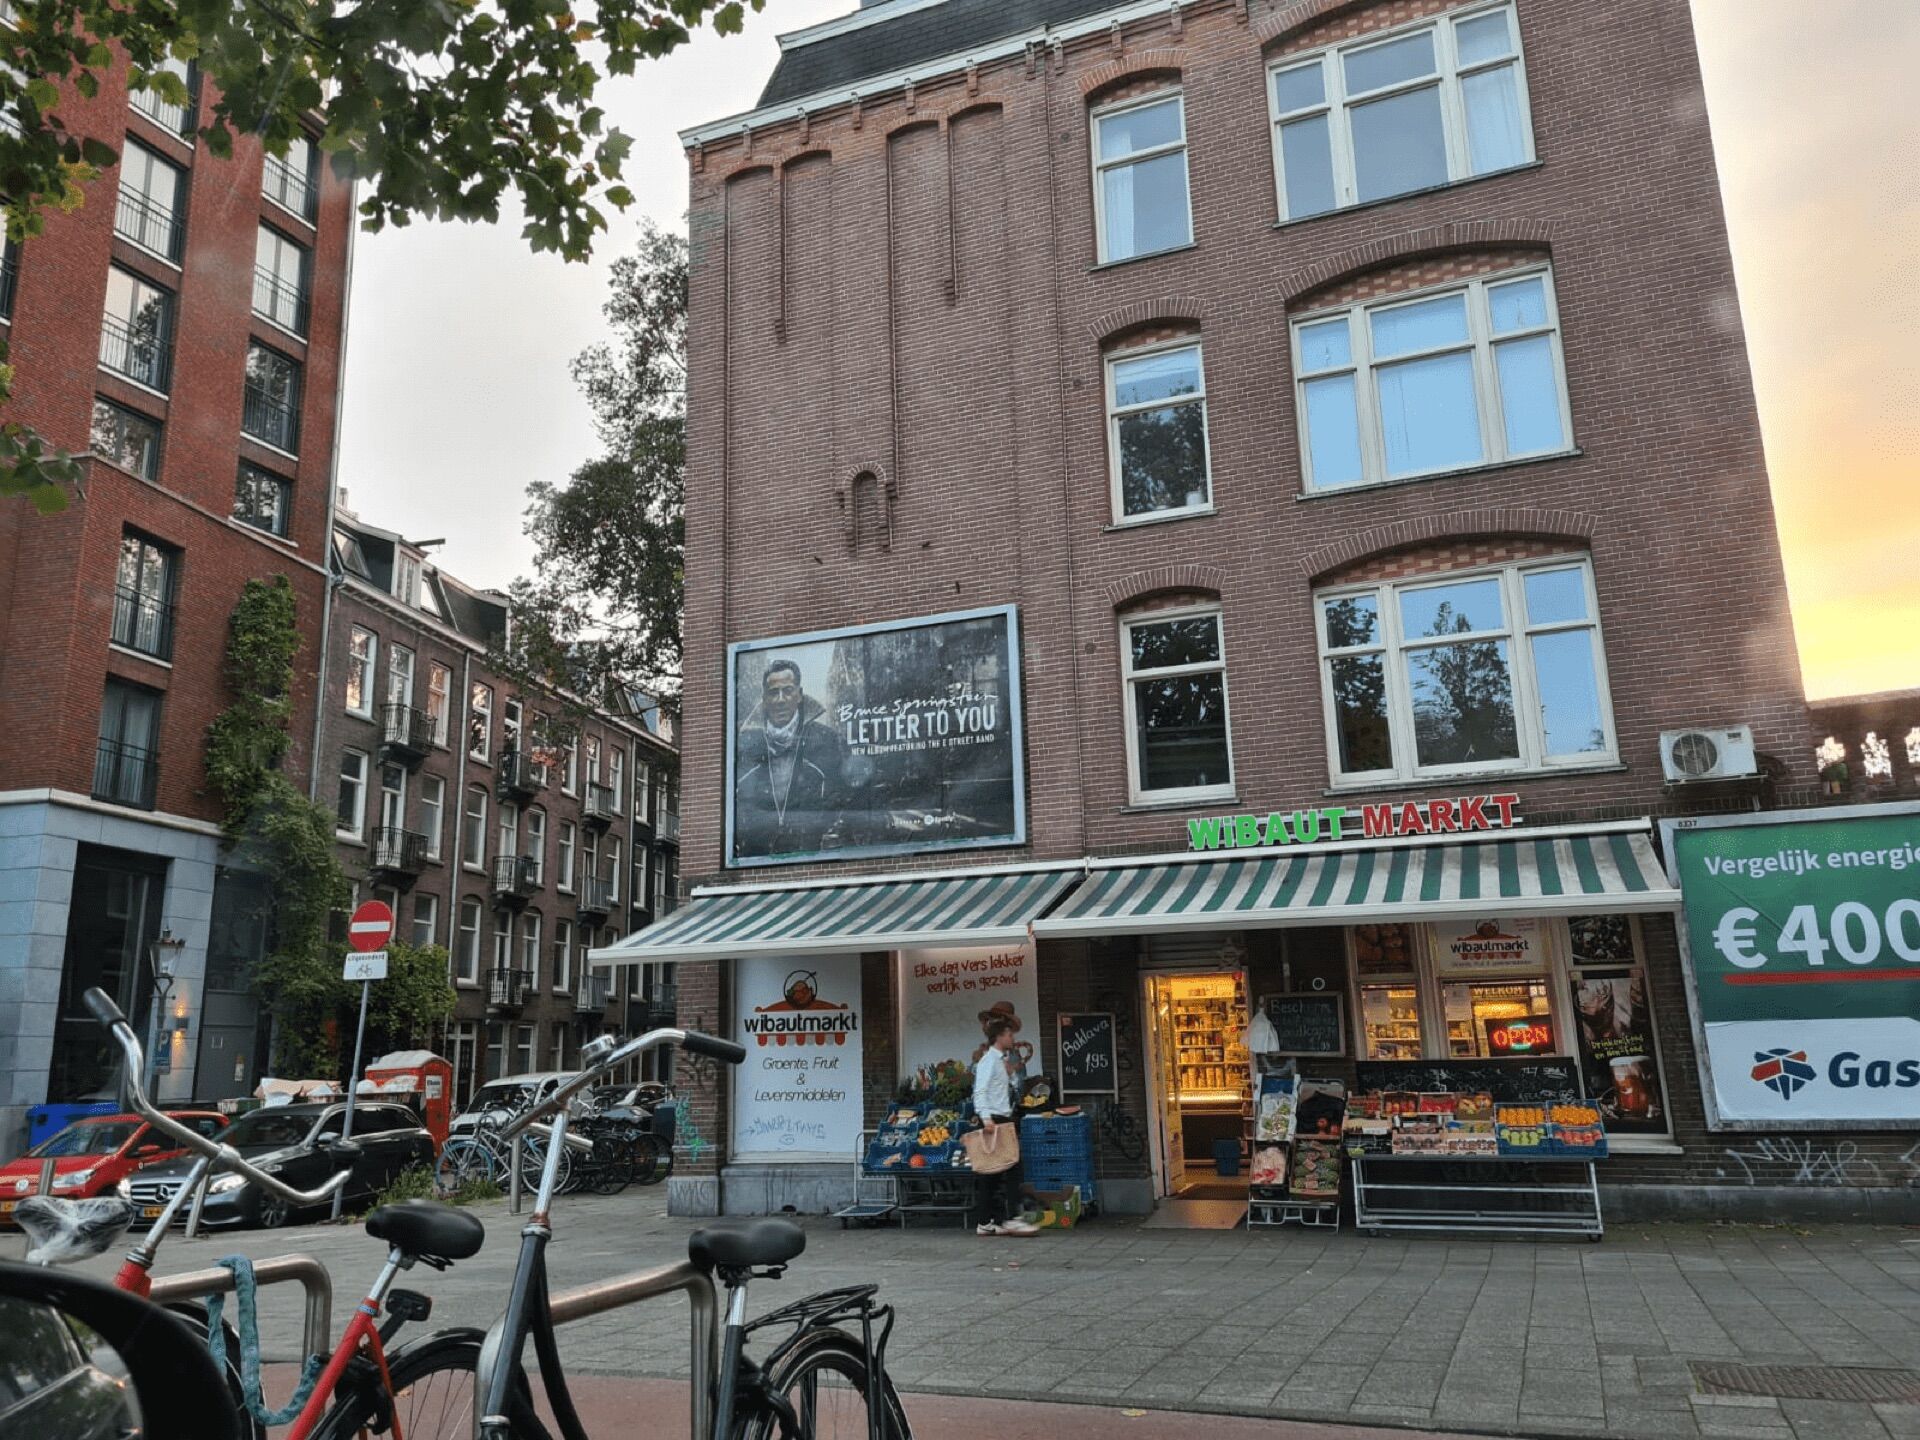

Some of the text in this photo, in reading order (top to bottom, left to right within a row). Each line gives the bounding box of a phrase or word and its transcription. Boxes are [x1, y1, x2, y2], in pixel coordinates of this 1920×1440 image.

[838, 703, 888, 722] Bruce
[846, 704, 996, 745] LETTER TO YOU
[1362, 793, 1520, 839] MARKT
[1703, 849, 1821, 878] Vergelijk
[1450, 940, 1530, 953] wibautmarkt
[914, 963, 938, 978] Elke
[939, 961, 960, 977] dag
[990, 953, 1025, 970] lekker
[927, 971, 1019, 995] eerlijk en gezond
[744, 1012, 858, 1033] wibautmarkt
[1062, 1020, 1110, 1057] Baklava
[1493, 1025, 1549, 1047] OPEN
[812, 1056, 840, 1070] Fruit
[1828, 1051, 1920, 1088] Gas
[796, 1072, 806, 1086] &
[754, 1088, 846, 1102] Levensmiddelen
